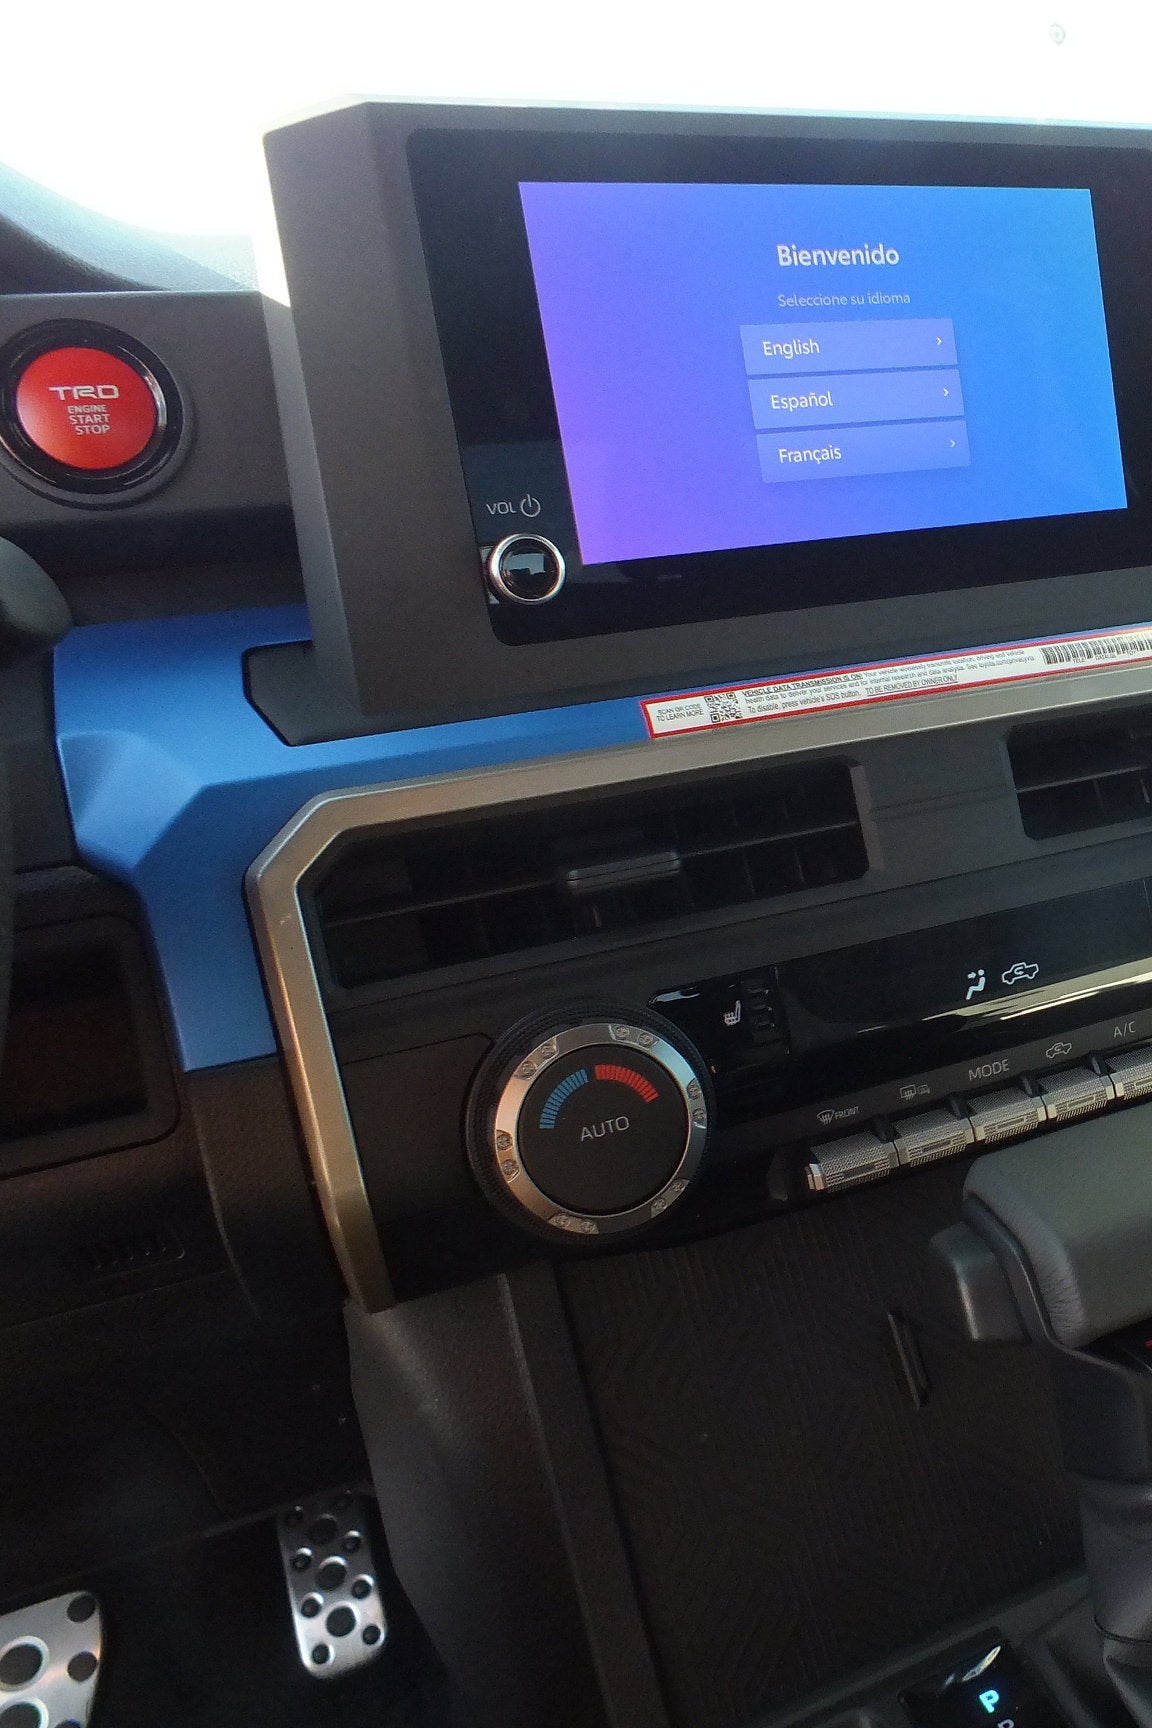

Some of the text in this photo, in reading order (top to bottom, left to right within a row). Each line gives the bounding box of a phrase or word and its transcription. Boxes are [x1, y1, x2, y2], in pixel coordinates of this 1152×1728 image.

[777, 244, 899, 266] Bienvenido
[778, 292, 911, 308] Seleccione su idioma
[763, 339, 820, 359] English
[49, 385, 119, 400] TRD
[67, 404, 107, 414] ENGINE
[771, 392, 833, 412] Español
[69, 414, 110, 424] START
[75, 424, 110, 435] STOP
[778, 445, 842, 465] Français
[486, 502, 517, 515] VOL
[742, 688, 772, 697] VEHICLE
[774, 685, 792, 694] DATA
[792, 677, 841, 690] TRANSMISSION
[850, 673, 863, 681] ON!
[745, 695, 764, 704] health
[765, 692, 779, 700] data
[788, 688, 808, 698] deliver
[810, 687, 822, 696] your
[824, 683, 847, 692] services
[870, 676, 891, 684] internal
[892, 673, 917, 681] research
[748, 706, 756, 714] To
[782, 700, 799, 710] press
[800, 696, 825, 706] vehicle's
[826, 693, 840, 702] SOS
[865, 687, 874, 696] TO
[875, 685, 883, 694] BE
[884, 681, 912, 692] REMOVED
[913, 680, 920, 688] BY
[922, 677, 942, 686] OWNER
[942, 674, 958, 683] ONLY
[657, 707, 674, 715] SCAN
[685, 703, 701, 711] CODE
[666, 712, 686, 721] LEARN
[686, 709, 704, 717] MORE
[1113, 1021, 1137, 1038] A/C
[967, 1058, 1010, 1081] MODE
[834, 1105, 860, 1121] FRONT
[580, 1116, 630, 1142] AUTO
[979, 1689, 1000, 1713] P
